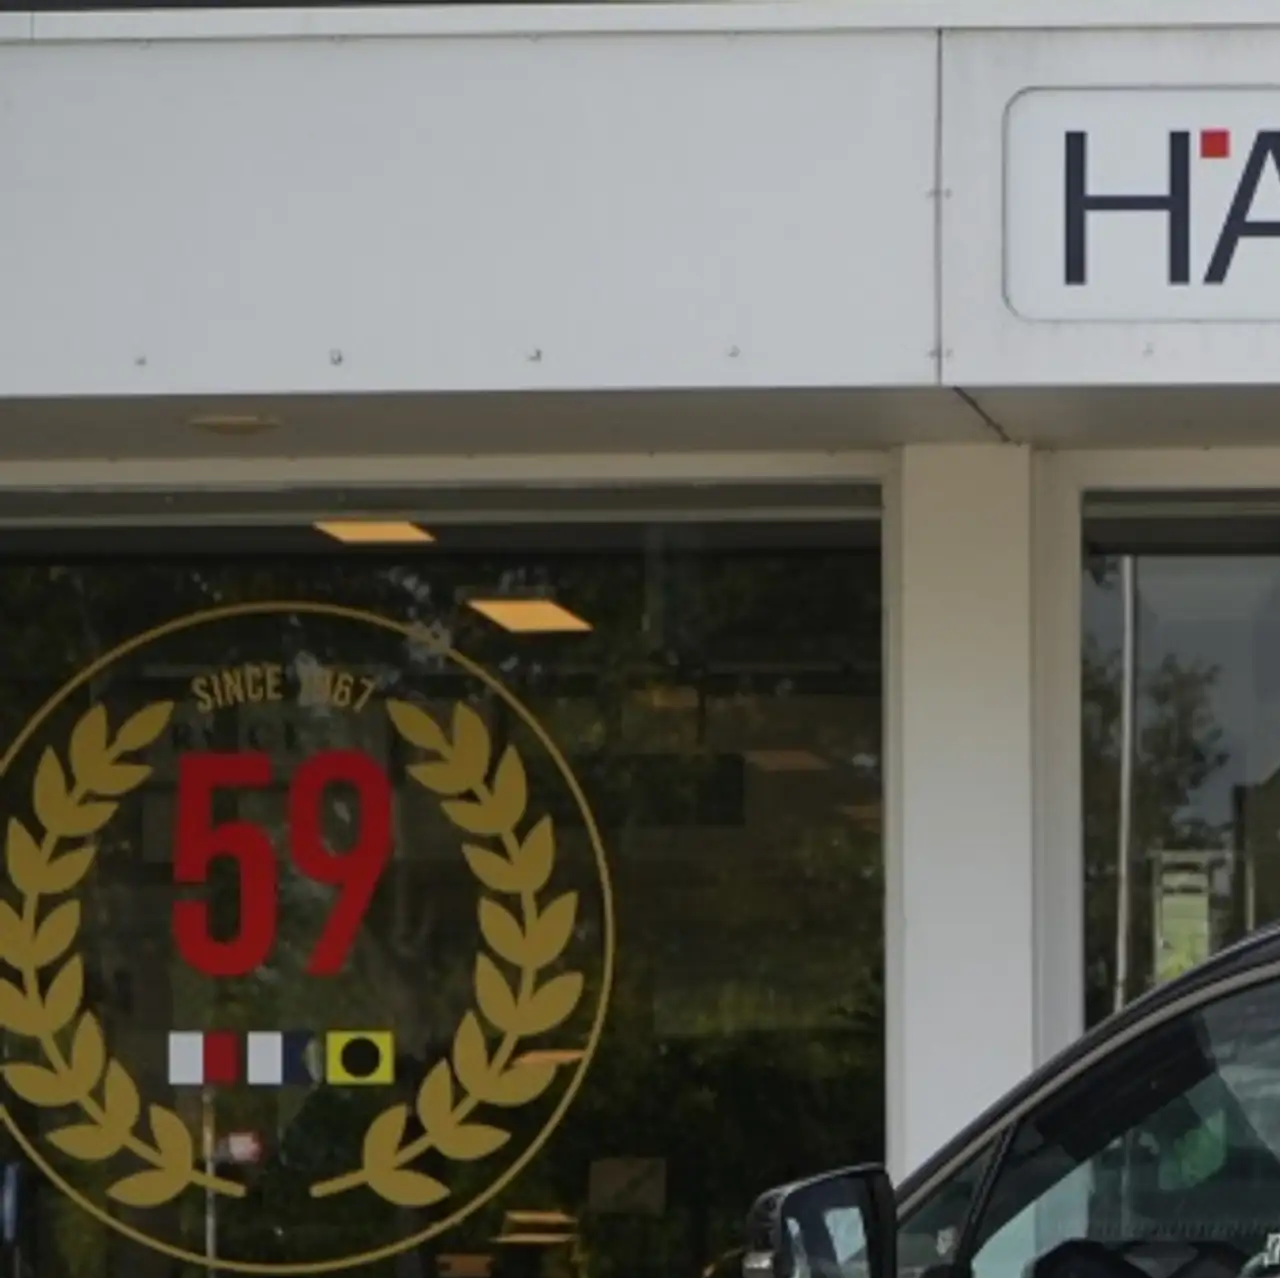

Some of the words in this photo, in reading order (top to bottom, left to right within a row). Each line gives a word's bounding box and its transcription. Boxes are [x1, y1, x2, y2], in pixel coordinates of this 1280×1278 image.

[191, 662, 284, 713] SINCE
[299, 667, 382, 713] 67
[173, 750, 392, 977] 59
